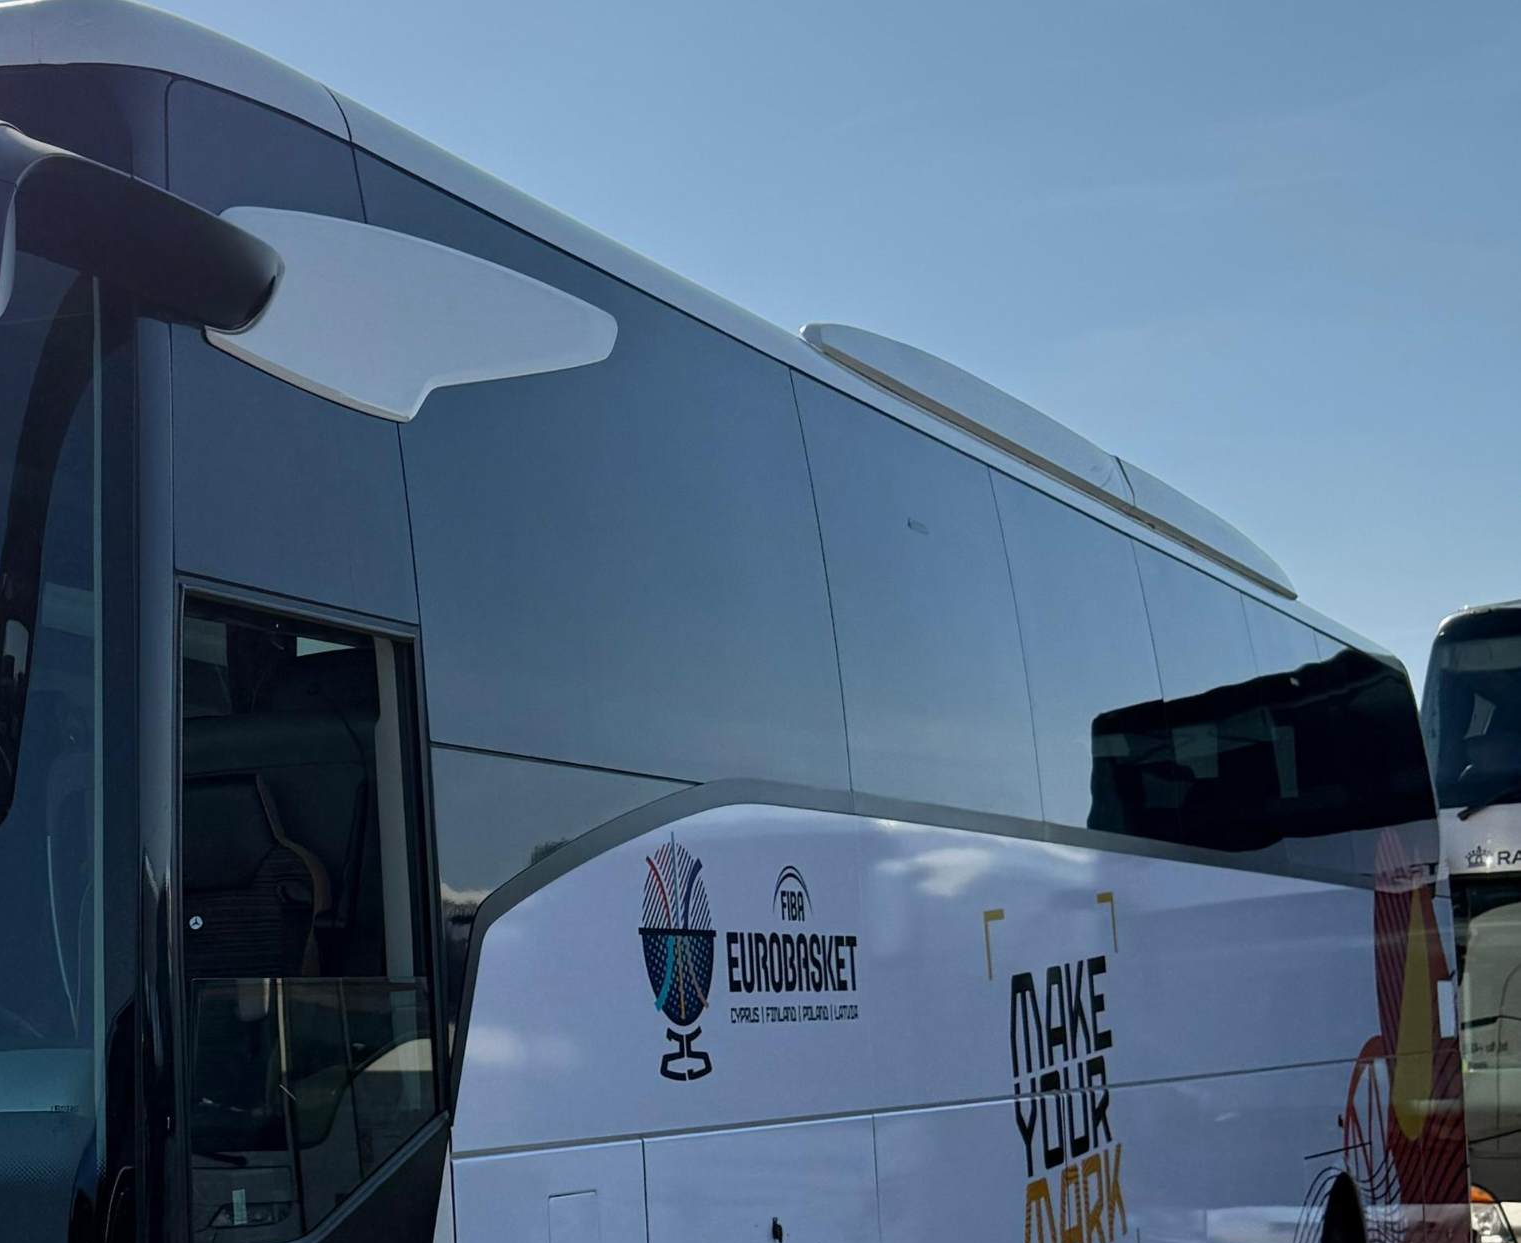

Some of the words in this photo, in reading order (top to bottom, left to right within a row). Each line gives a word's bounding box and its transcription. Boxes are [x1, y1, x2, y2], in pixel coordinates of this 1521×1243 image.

[780, 890, 806, 922] FIBA
[726, 931, 858, 993] EUROBASKET
[730, 1007, 760, 1024] CYPRUS
[766, 1006, 797, 1022] FINLAND
[802, 1005, 829, 1021] POLAND
[1009, 955, 1114, 1078] MAKE
[1014, 1055, 1113, 1178] YOUR
